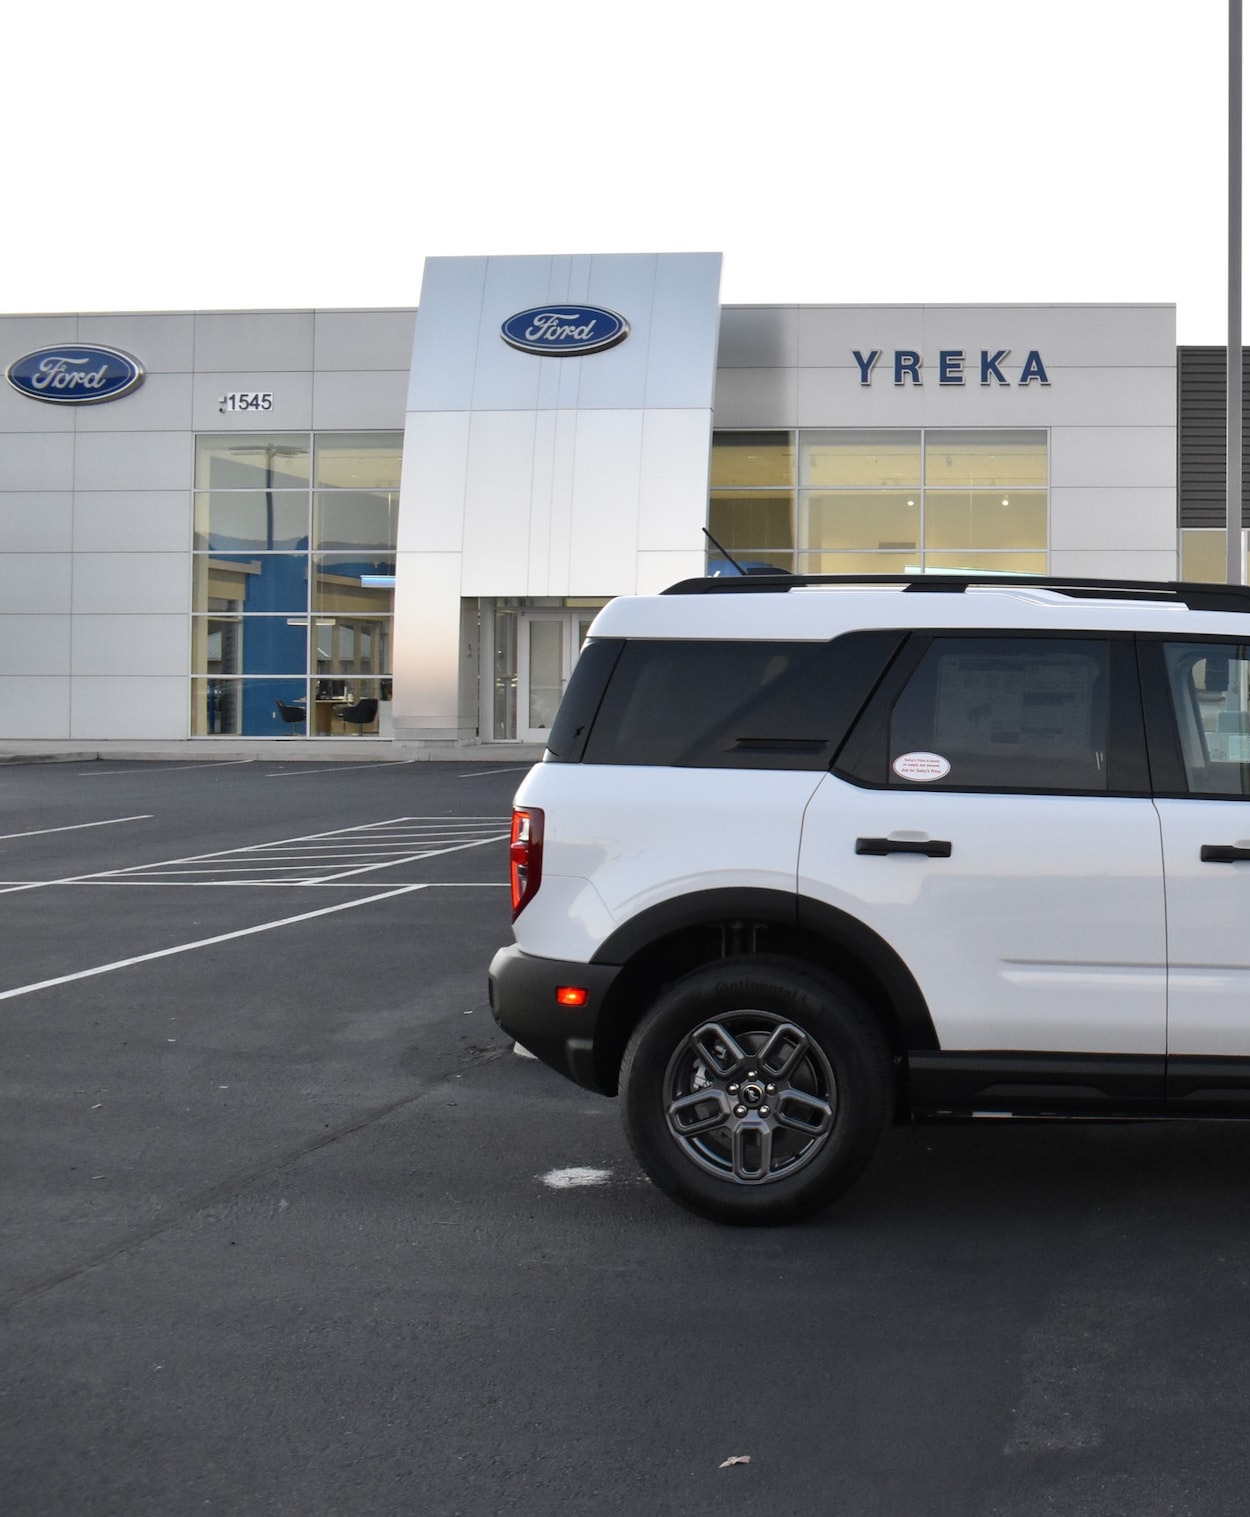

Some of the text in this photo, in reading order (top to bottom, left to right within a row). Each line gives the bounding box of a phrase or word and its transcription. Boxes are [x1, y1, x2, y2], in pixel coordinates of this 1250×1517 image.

[525, 313, 596, 341] Ford
[32, 357, 108, 389] Ford
[852, 349, 1050, 386] YREKA
[229, 394, 272, 410] 1545
